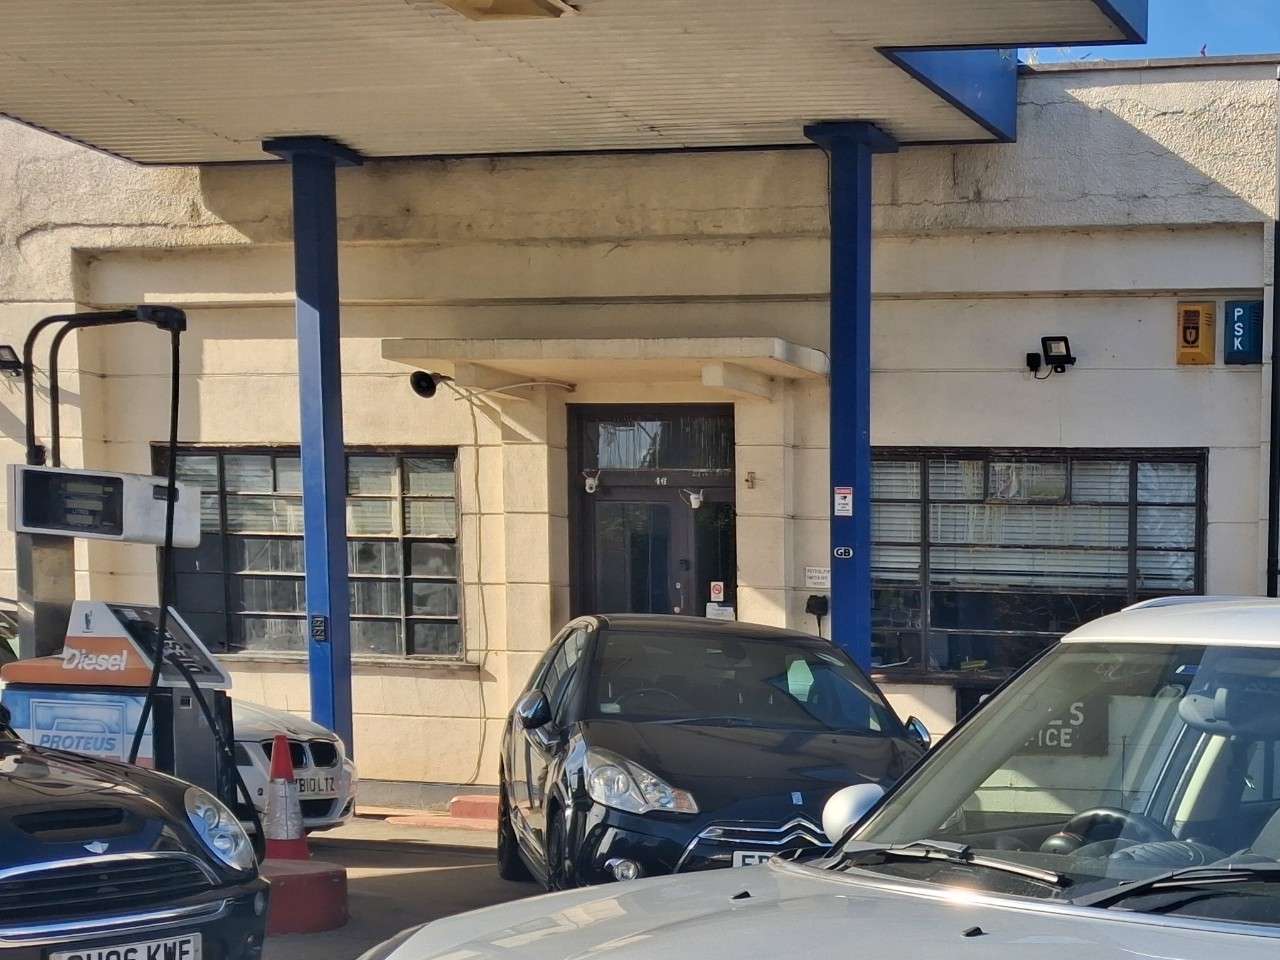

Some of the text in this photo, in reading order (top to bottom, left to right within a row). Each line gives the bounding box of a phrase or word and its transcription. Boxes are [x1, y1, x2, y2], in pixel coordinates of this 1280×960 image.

[835, 548, 851, 557] GB
[62, 648, 128, 671] Diesel
[39, 733, 118, 752] PROTEUS
[295, 777, 316, 792] B10
